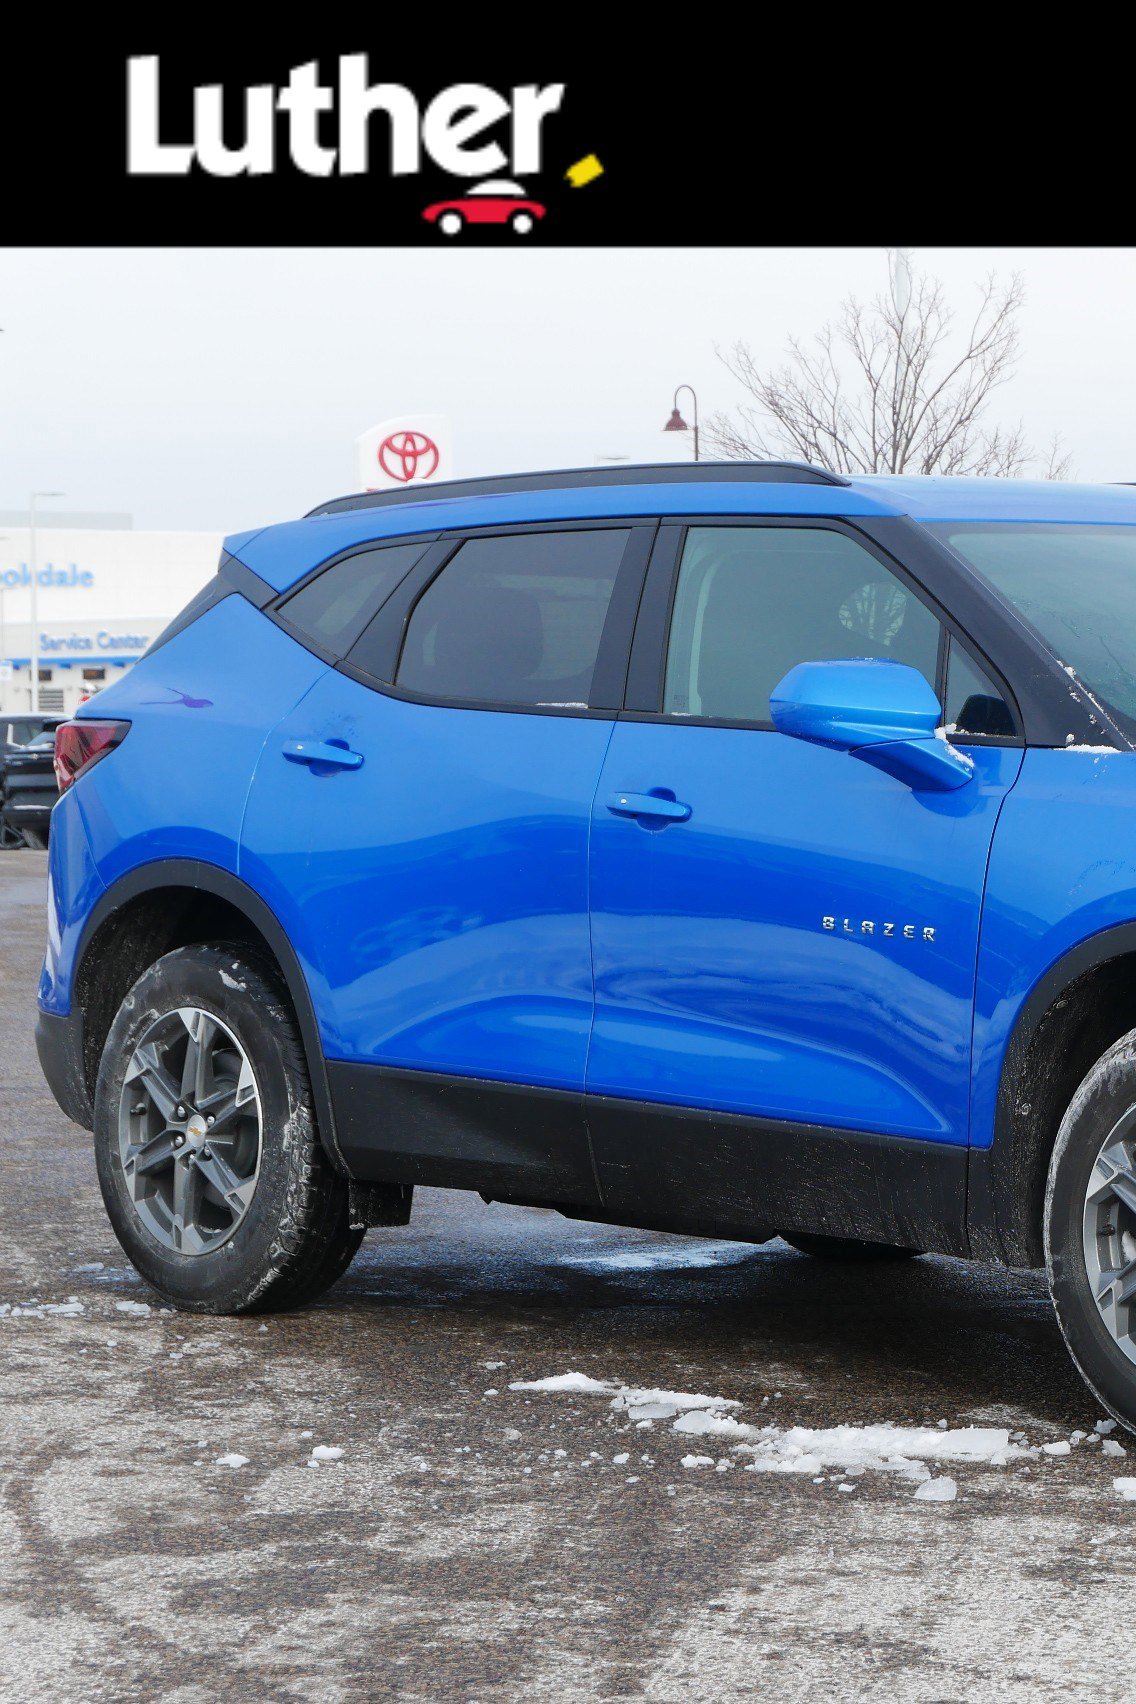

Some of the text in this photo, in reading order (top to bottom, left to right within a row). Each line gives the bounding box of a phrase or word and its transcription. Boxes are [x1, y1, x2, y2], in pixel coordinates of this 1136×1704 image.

[40, 631, 148, 650] Service Center
[822, 915, 936, 942] BLAZER
